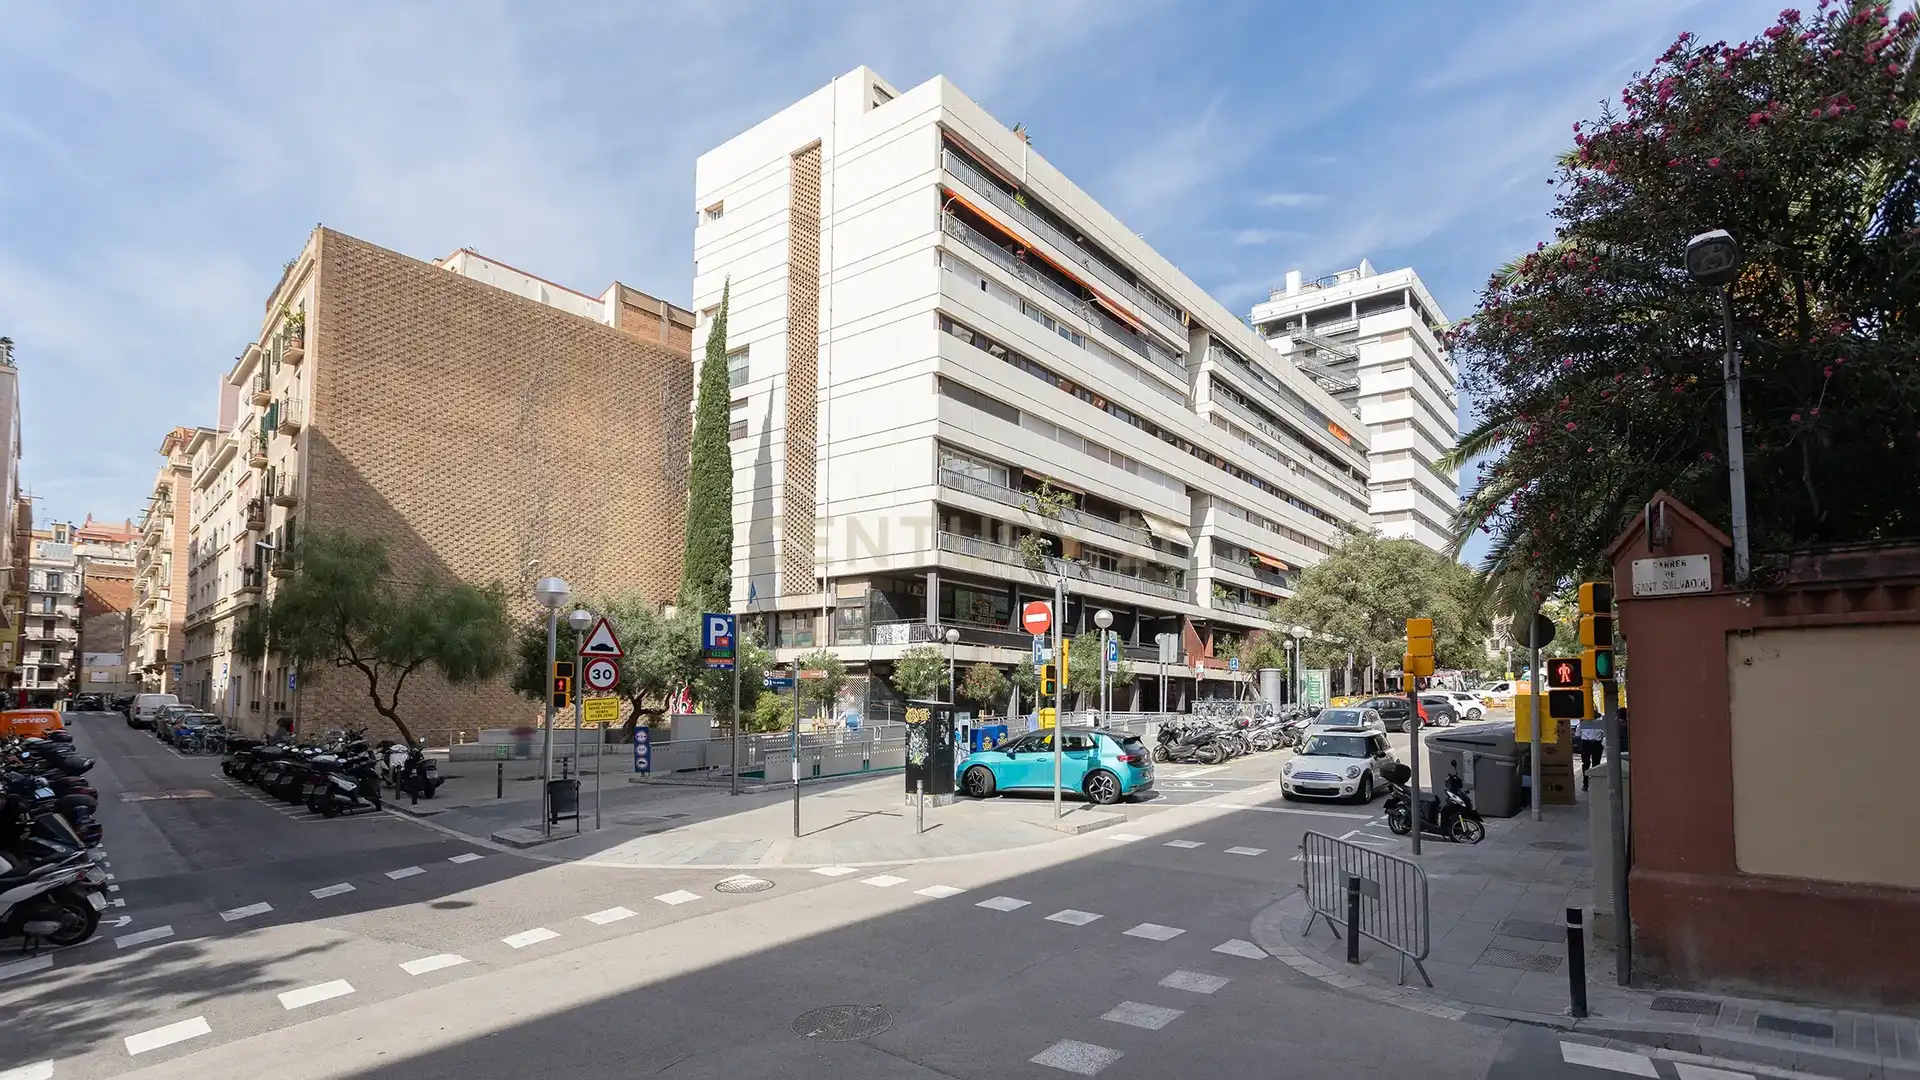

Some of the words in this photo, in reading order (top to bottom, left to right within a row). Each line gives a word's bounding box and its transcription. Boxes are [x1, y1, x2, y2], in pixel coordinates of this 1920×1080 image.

[1653, 560, 1687, 569] CARRER
[1634, 581, 1658, 593] SANT
[1662, 578, 1709, 590] SALVADOR
[710, 617, 729, 646] P
[1036, 643, 1043, 661] P
[1110, 643, 1117, 659] P
[592, 669, 612, 680] 30
